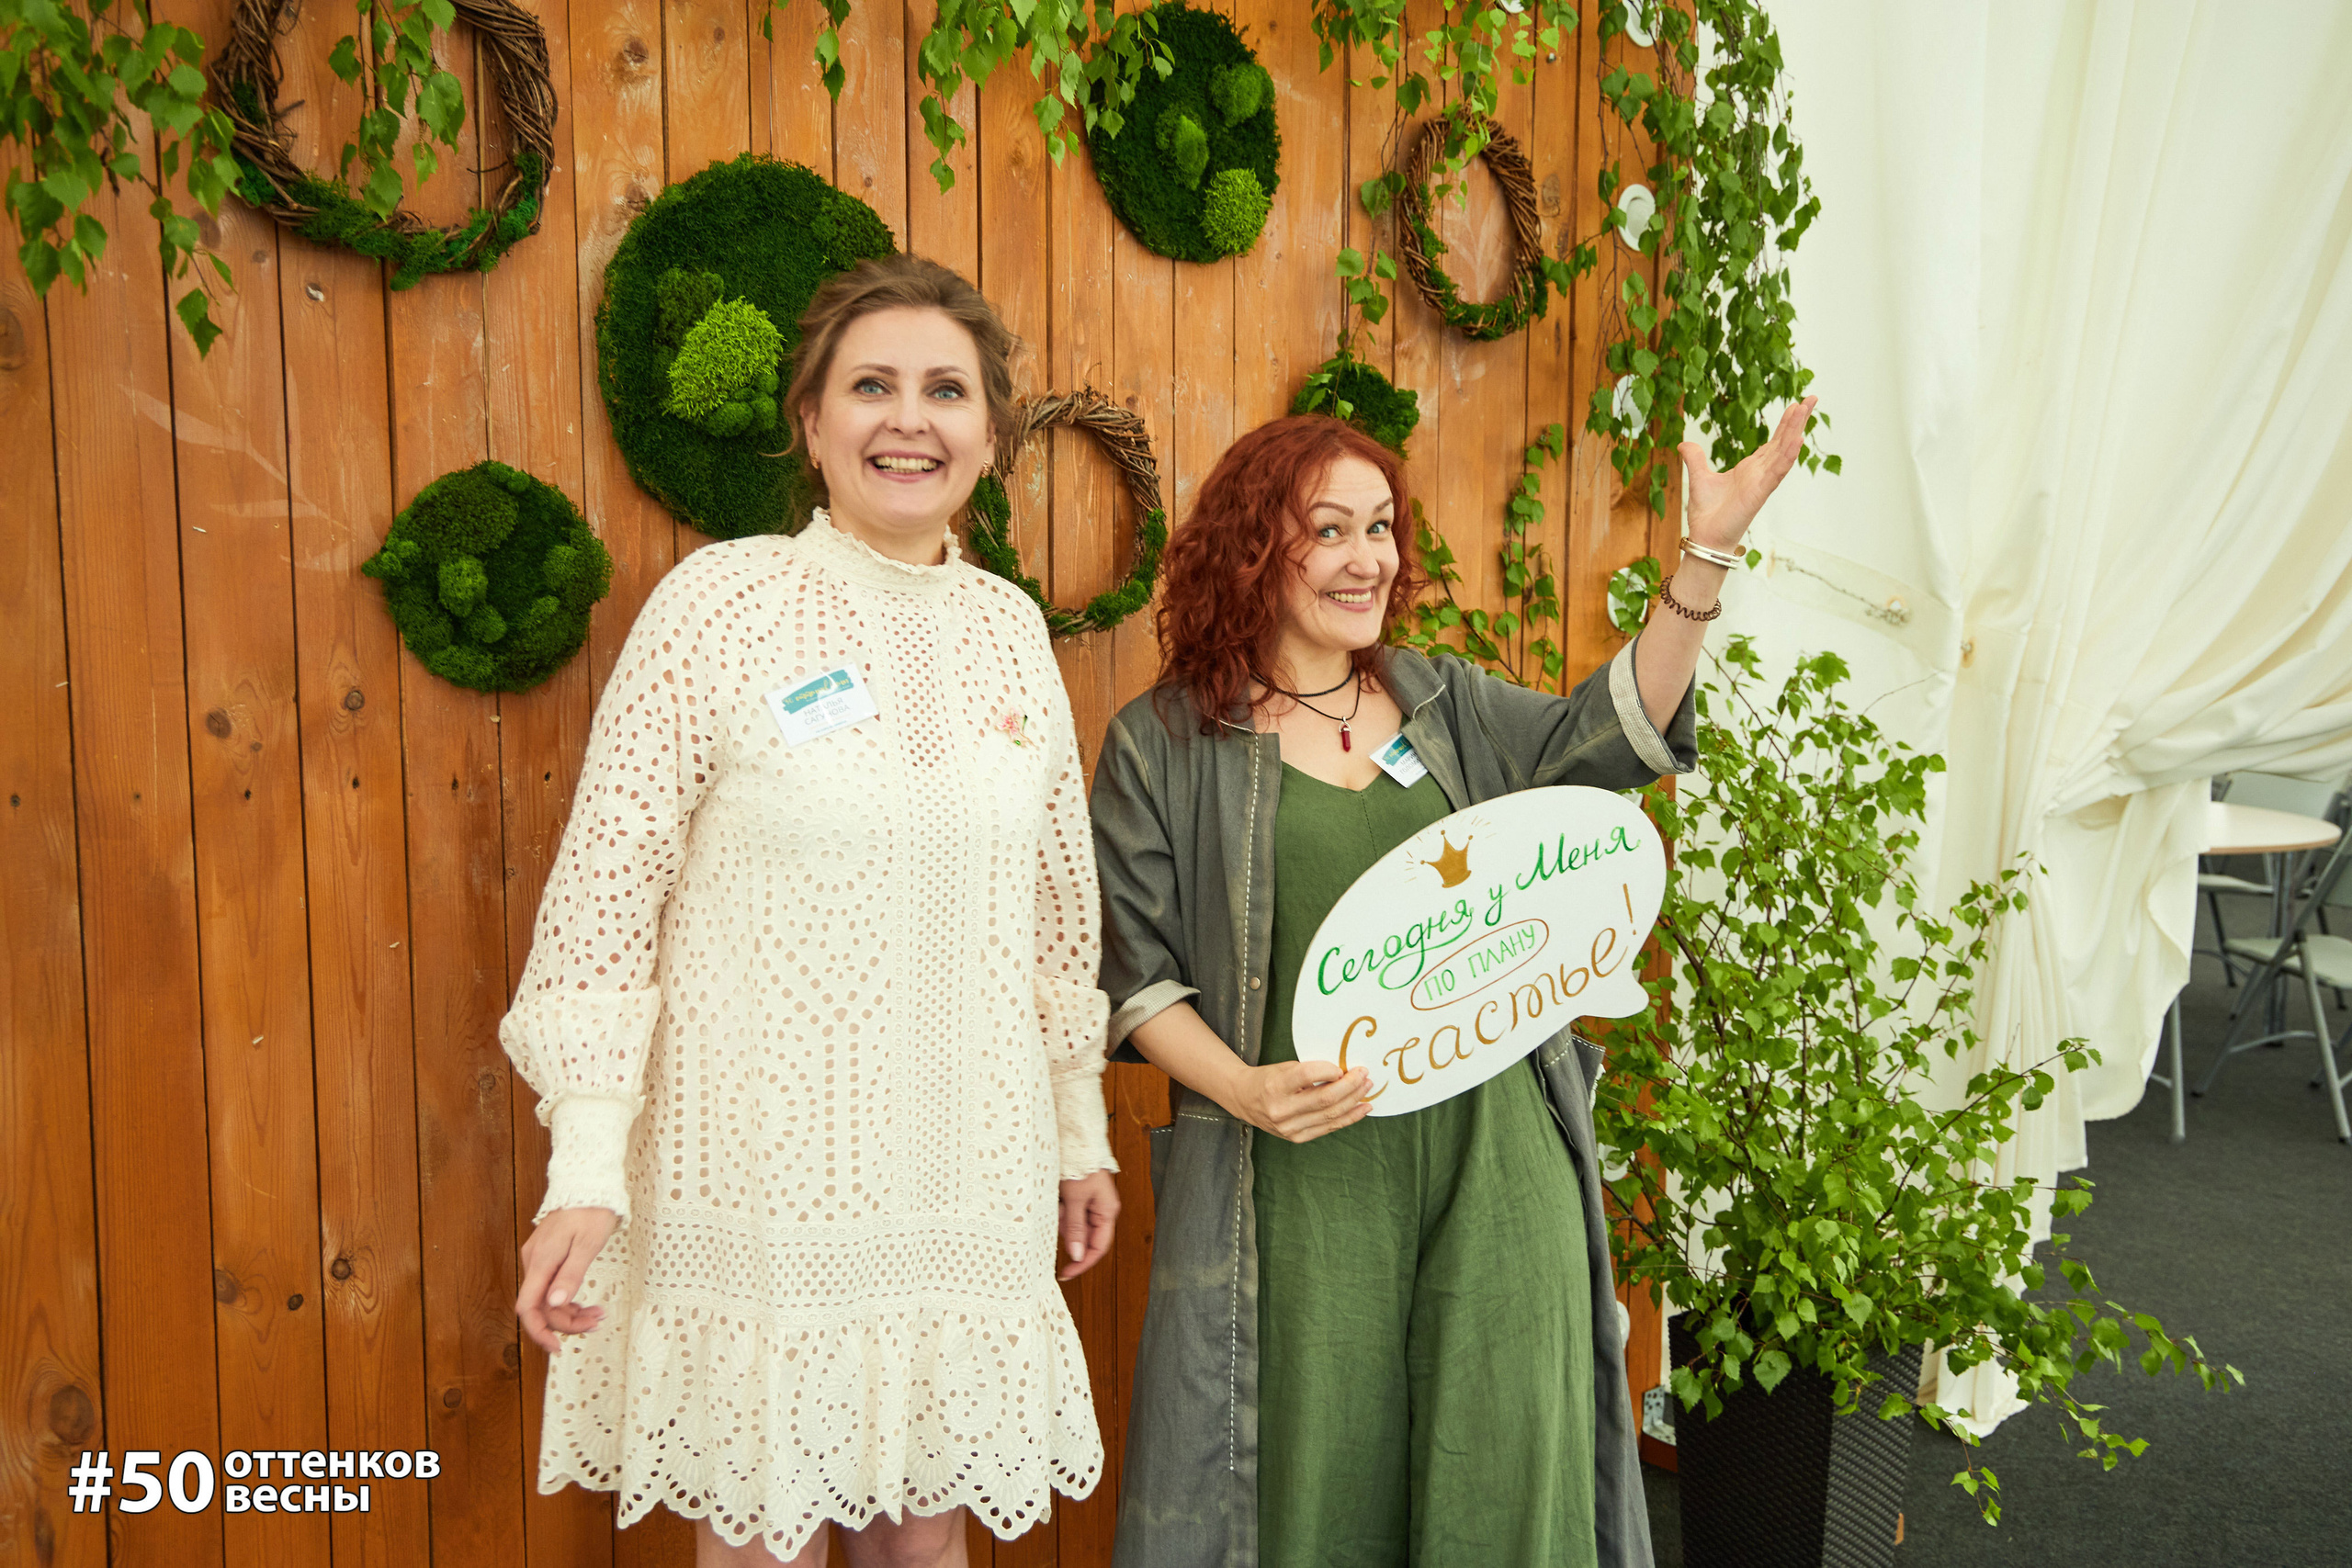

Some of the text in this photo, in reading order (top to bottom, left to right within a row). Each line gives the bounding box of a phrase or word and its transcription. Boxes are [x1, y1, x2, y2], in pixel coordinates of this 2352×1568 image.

[1317, 826, 1641, 996] Сегодня у Меня
[1424, 924, 1536, 1001] ПО ПЛАНУ
